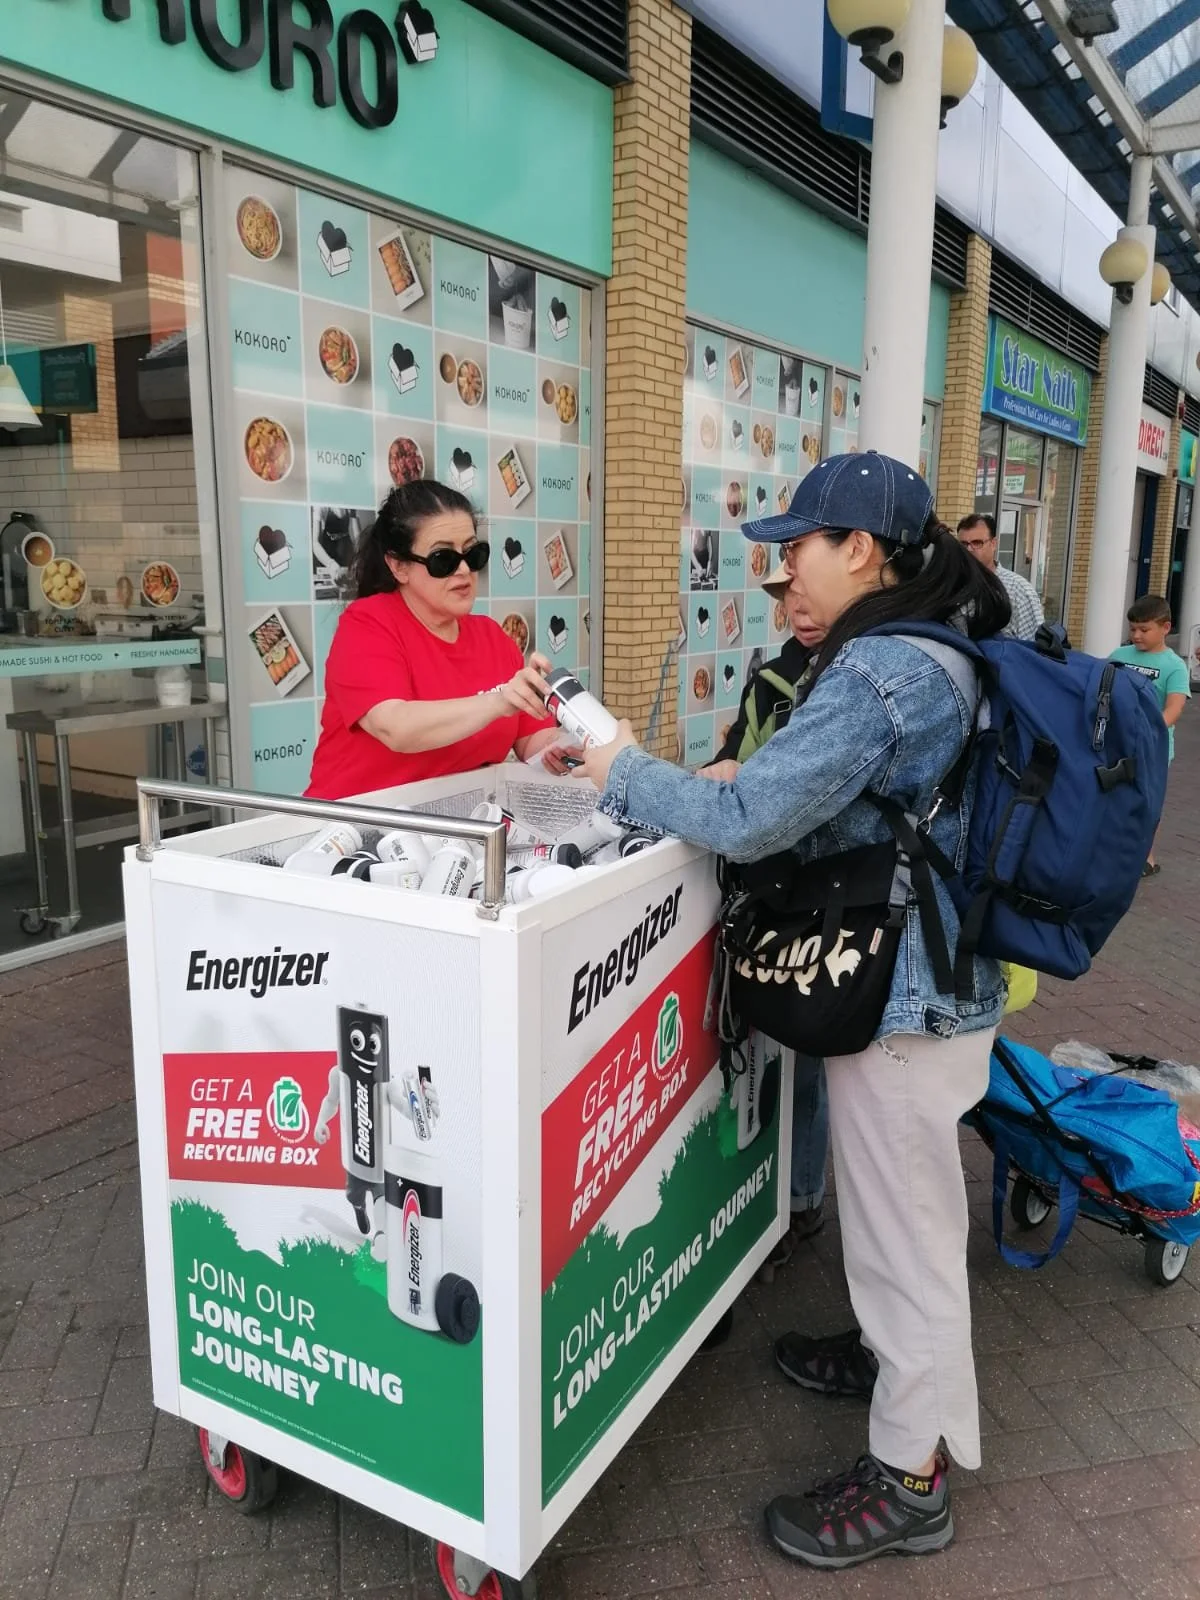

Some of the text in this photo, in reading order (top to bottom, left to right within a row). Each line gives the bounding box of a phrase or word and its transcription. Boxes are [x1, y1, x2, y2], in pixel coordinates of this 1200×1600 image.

[440, 279, 477, 302] KOKORO
[234, 329, 287, 353] KOKORO
[495, 387, 528, 403] KOKORO
[1001, 335, 1077, 415] Star Nails
[317, 449, 362, 468] KOKORO
[1138, 419, 1165, 459] DIRECT
[542, 476, 571, 491] KOKORO
[29, 655, 52, 666] SUSHI
[54, 655, 60, 664] &
[62, 654, 79, 664] HOT
[80, 653, 103, 662] FOOD
[159, 647, 199, 657] HANDMADE
[254, 743, 303, 762] KOKORO
[186, 946, 330, 998] Energizer
[567, 883, 684, 1036] Energizer
[190, 1078, 253, 1102] GET A
[582, 1032, 641, 1124] GET A
[185, 1107, 263, 1140] FREE
[354, 1080, 370, 1165] Energizer
[569, 1109, 657, 1232] RECYCLING
[660, 1057, 690, 1121] BOX
[574, 1063, 648, 1191] FREE
[183, 1143, 321, 1166] RECYCLING BOX
[408, 1221, 422, 1288] Energizer
[187, 1258, 315, 1332] JOIN OUR
[553, 1232, 703, 1430] LONG-LASTING
[706, 1153, 774, 1251] JOURNEY
[553, 1296, 606, 1381] JOIN
[612, 1246, 656, 1313] OUR
[189, 1292, 404, 1405] LONG-LASTING
[191, 1331, 320, 1406] JOURNEY
[903, 1476, 931, 1492] CAT
